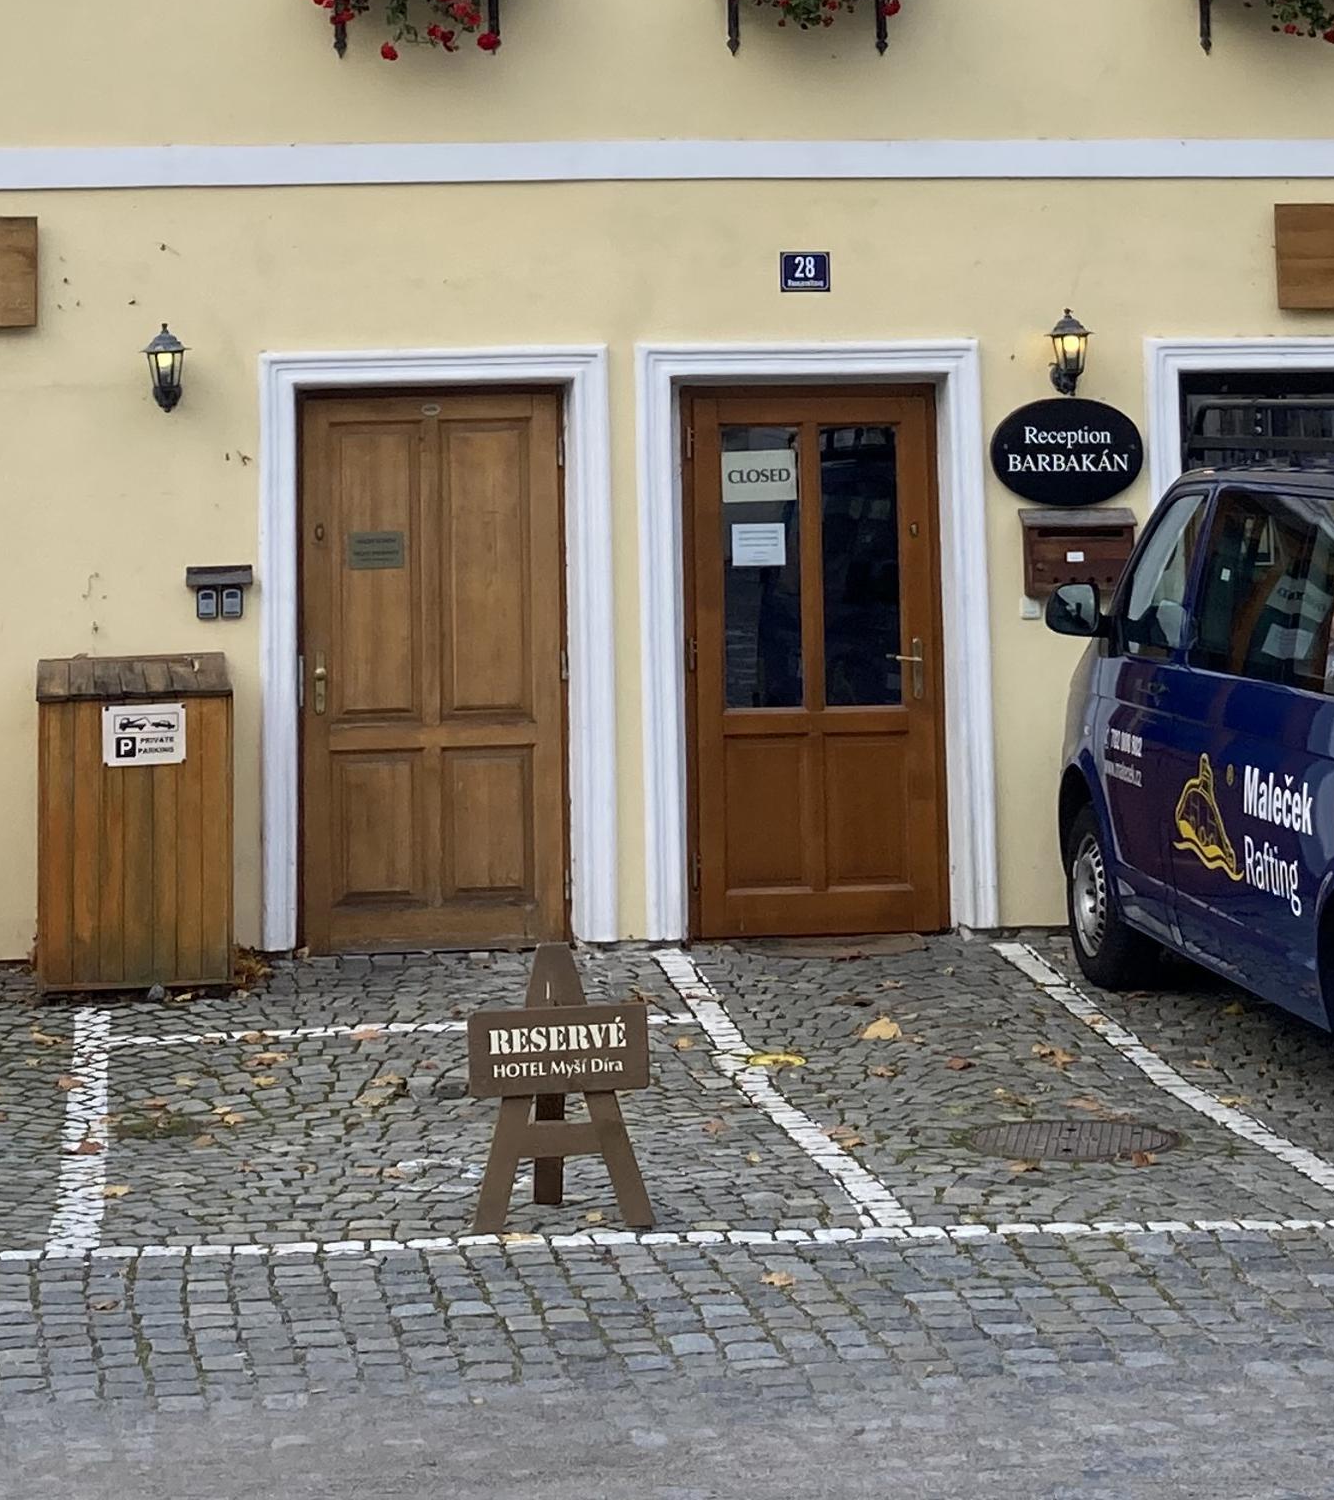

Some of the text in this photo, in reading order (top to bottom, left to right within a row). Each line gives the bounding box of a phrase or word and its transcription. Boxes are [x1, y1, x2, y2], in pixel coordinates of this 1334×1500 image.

[794, 256, 816, 278] 28
[1024, 425, 1112, 449] Reception
[1007, 449, 1129, 472] BARBAKÁN
[727, 467, 791, 484] CLOSED
[1243, 764, 1313, 836] Maleček
[1244, 834, 1302, 917] Rafting
[488, 1016, 627, 1055] RESERVÉ
[493, 1057, 624, 1079] HOTEL Myší Díra
